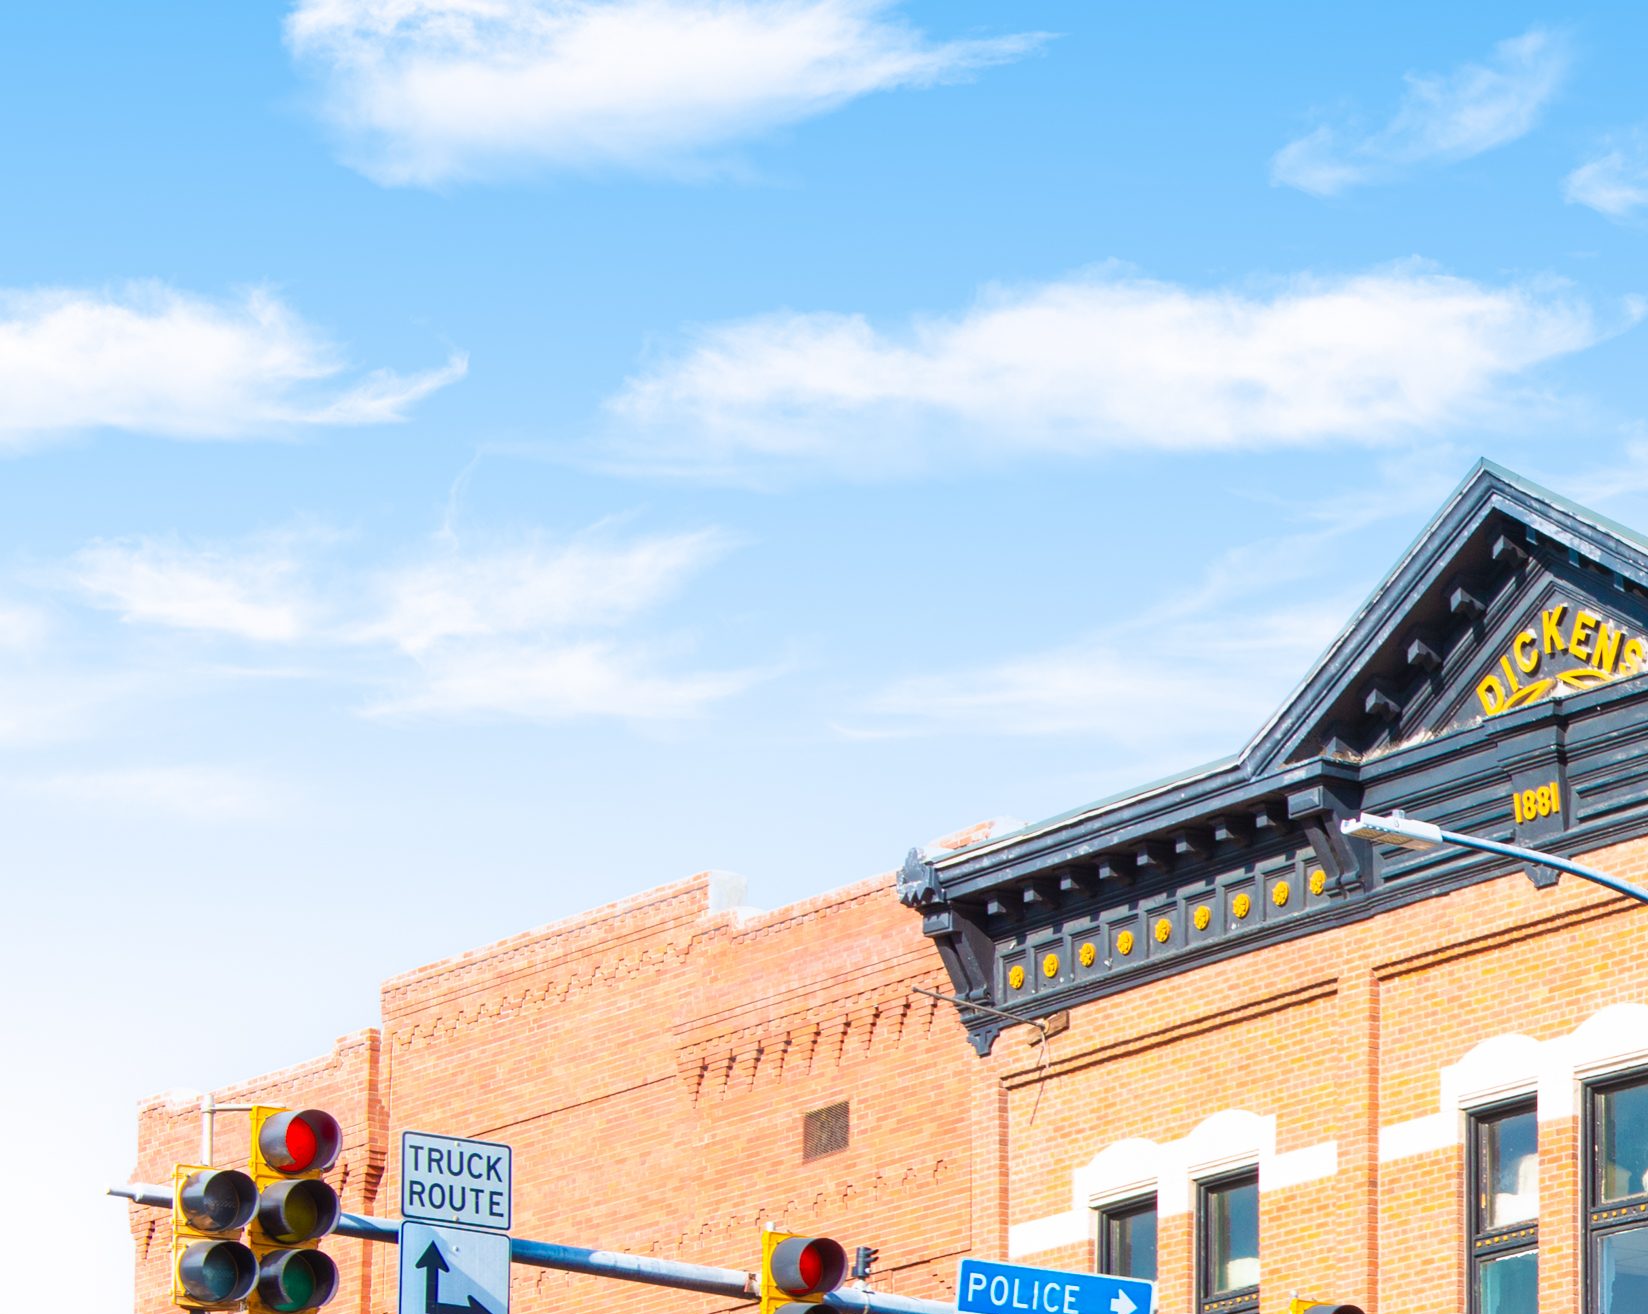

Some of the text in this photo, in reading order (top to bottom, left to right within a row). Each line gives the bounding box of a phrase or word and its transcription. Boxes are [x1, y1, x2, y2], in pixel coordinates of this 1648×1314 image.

[1476, 604, 1645, 713] DICKENS
[1513, 781, 1560, 824] 1881
[409, 1145, 503, 1183] TRUCK
[409, 1179, 504, 1218] ROUTE
[967, 1272, 1081, 1314] POLICE
